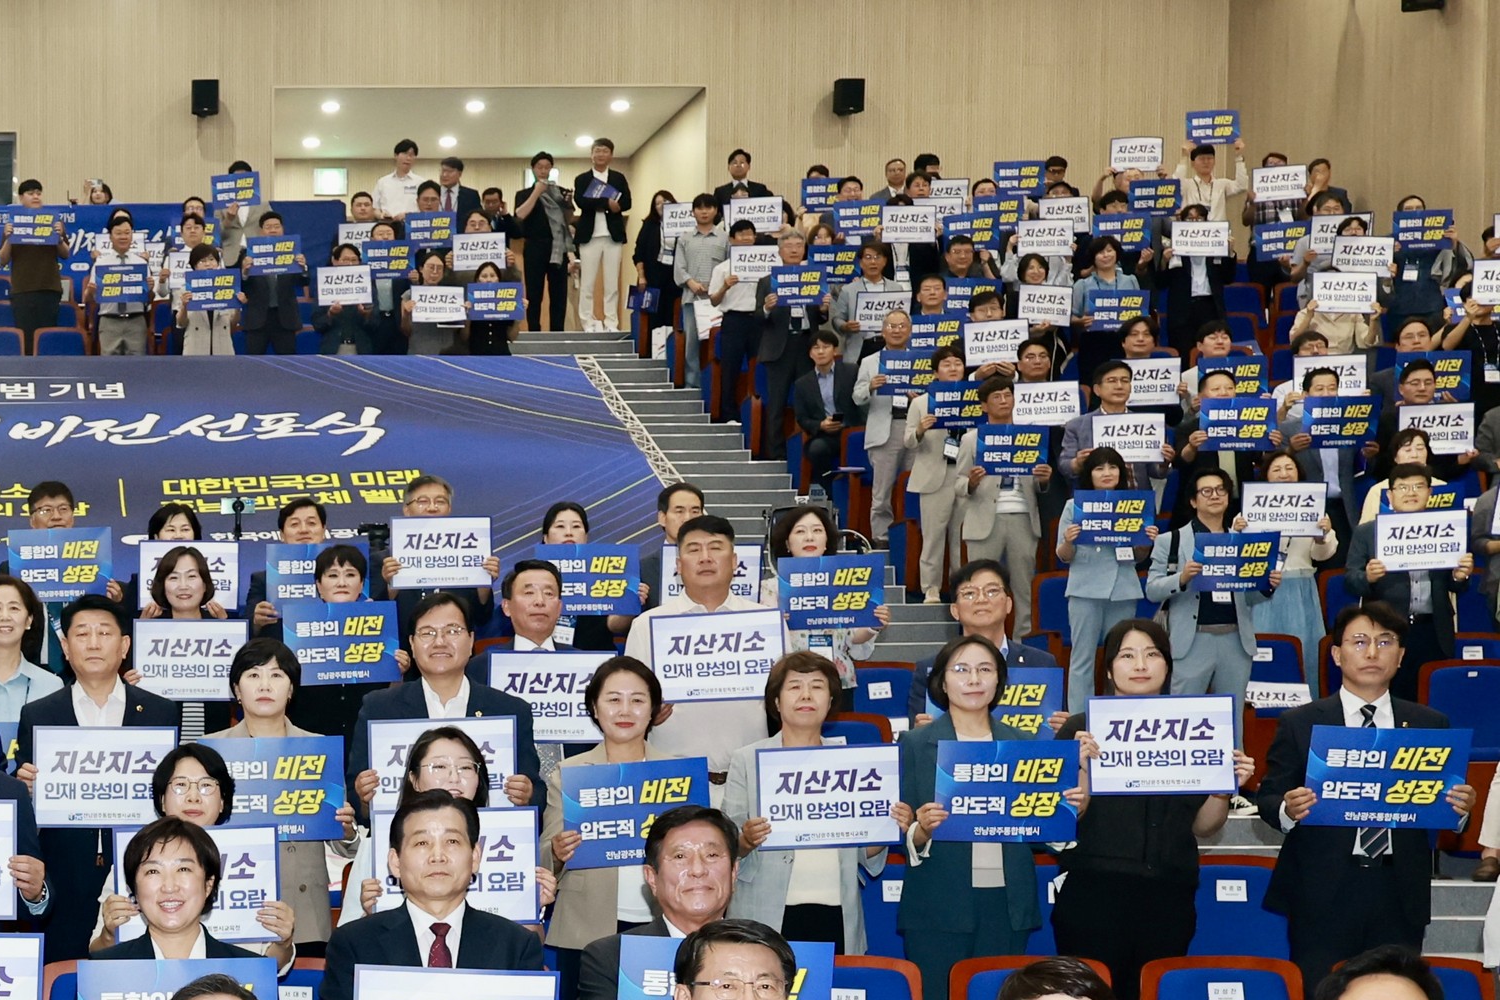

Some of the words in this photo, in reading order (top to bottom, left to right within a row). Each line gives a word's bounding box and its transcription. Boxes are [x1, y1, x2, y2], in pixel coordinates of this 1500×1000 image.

[49, 381, 125, 400] 기념
[8, 415, 174, 448] 비전
[169, 406, 385, 456] 선포식
[162, 473, 341, 496] 대한민국의
[351, 469, 421, 487] 미래
[1083, 502, 1112, 512] 통합의
[1115, 500, 1145, 513] 비전
[1082, 520, 1111, 530] 압도적
[1114, 518, 1143, 532] 성장
[1388, 524, 1455, 540] 지산지소
[20, 545, 58, 559] 통합의
[62, 541, 99, 558] 비전
[404, 533, 478, 550] 지산지소
[668, 631, 765, 655] 지산지소
[1105, 718, 1215, 742] 지산지소
[1101, 753, 1133, 769] 인재
[1137, 750, 1186, 767] 양성의
[1191, 749, 1224, 765] 요람
[1326, 749, 1386, 768] 통합의
[1390, 747, 1451, 771] 비전
[776, 768, 882, 794] 지산지소
[1322, 781, 1381, 800] 압도적
[1385, 780, 1444, 803] 성장
[579, 786, 633, 807] 통합의
[639, 777, 690, 803] 비전
[770, 804, 802, 821] 인재
[807, 801, 855, 819] 양성의
[860, 800, 891, 817] 요람
[1346, 812, 1416, 822] 전남광주통합특별시
